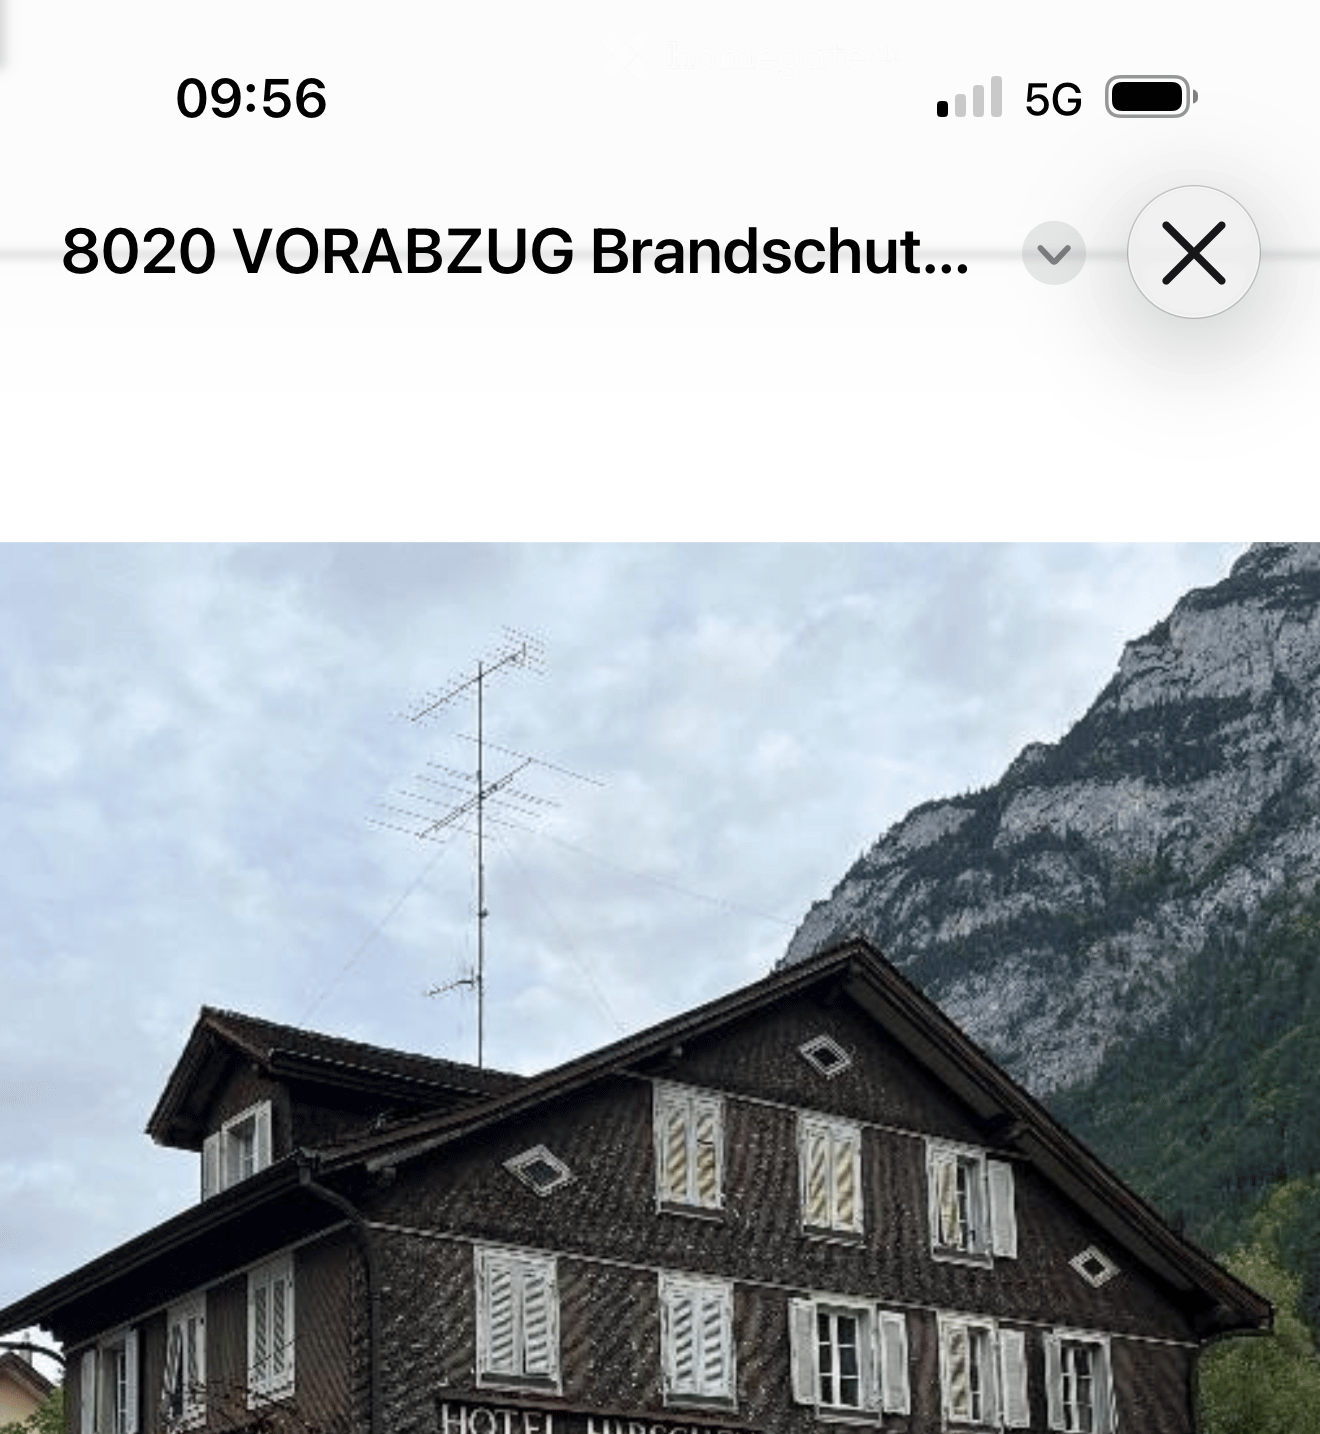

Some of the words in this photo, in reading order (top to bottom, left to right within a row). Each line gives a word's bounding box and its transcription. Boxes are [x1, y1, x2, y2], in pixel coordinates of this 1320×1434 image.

[176, 77, 327, 119] 09:56
[1026, 82, 1082, 117] 5G
[63, 227, 216, 275] 8020
[232, 227, 573, 275] VORABZUG
